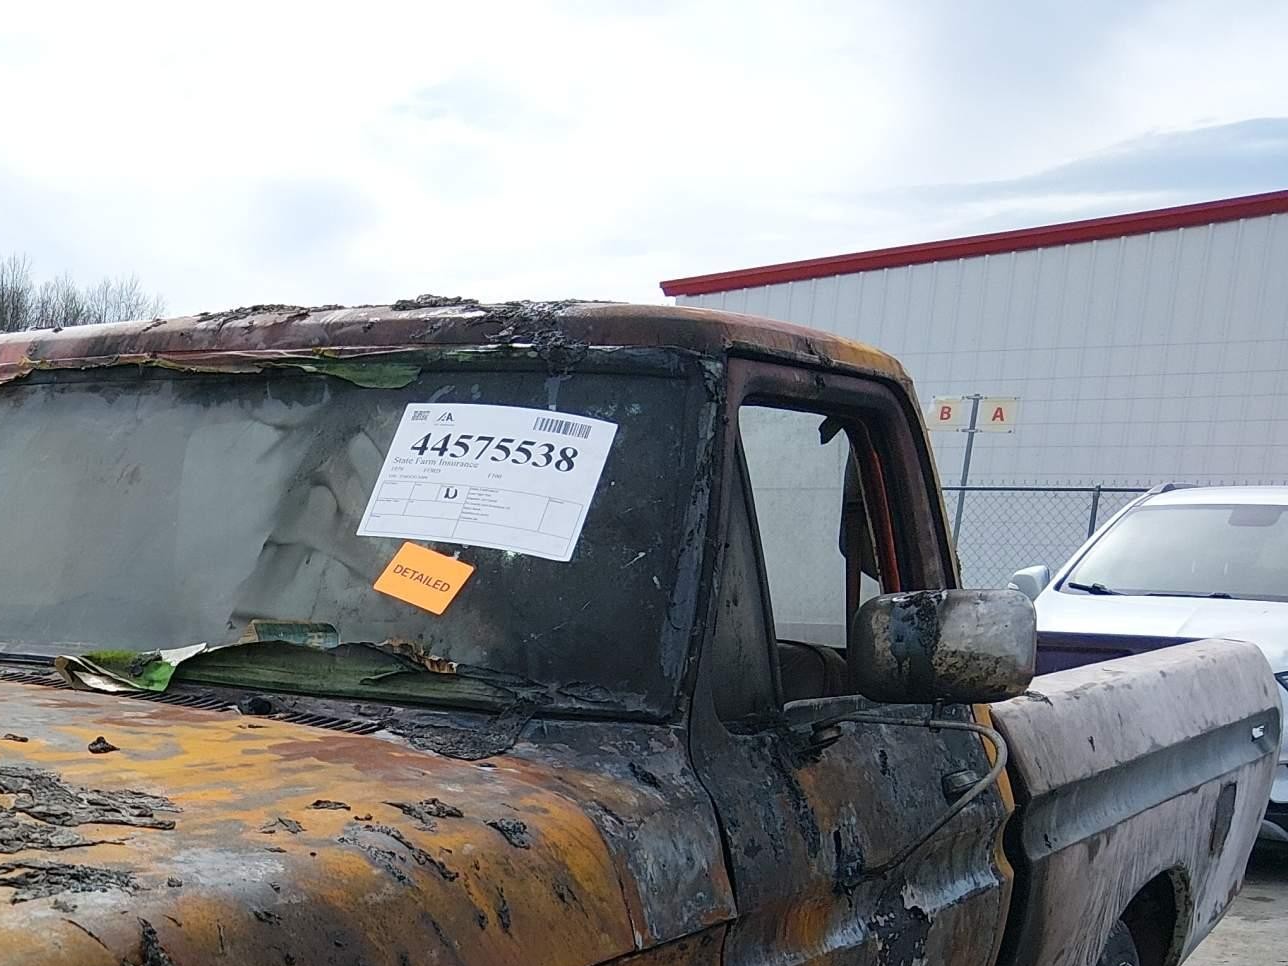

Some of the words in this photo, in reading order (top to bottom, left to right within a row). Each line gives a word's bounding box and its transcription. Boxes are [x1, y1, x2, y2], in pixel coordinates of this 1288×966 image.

[940, 406, 952, 421] B
[992, 407, 1004, 422] A
[411, 432, 579, 473] 44575538
[393, 456, 413, 465] State
[415, 457, 437, 467] Farm
[438, 459, 479, 469] Insurance
[393, 564, 451, 593] DETAILED
